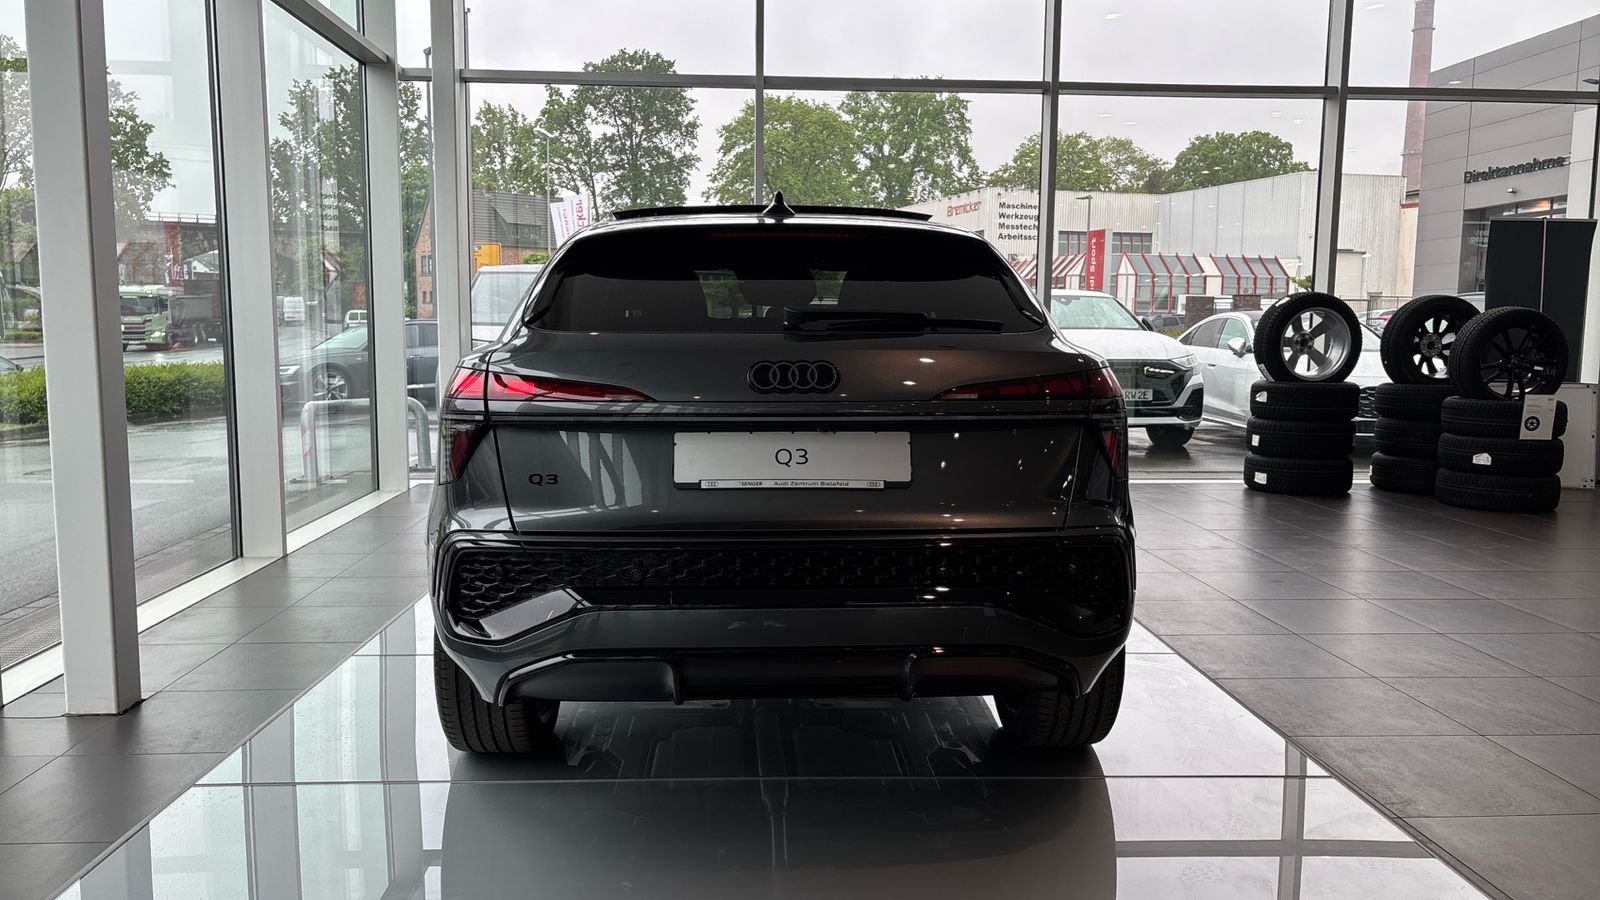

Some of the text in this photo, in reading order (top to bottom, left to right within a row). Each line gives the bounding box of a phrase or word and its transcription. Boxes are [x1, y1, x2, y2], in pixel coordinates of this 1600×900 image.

[1464, 156, 1567, 184] Direktannahme
[946, 200, 982, 217] Bremicker
[998, 202, 1038, 210] Maschine
[998, 212, 1039, 222] Werkzeug
[998, 222, 1039, 231] Messtech
[998, 233, 1038, 241] Arbeitssc
[1089, 236, 1097, 273] Sport
[774, 448, 809, 468] Q3
[528, 473, 558, 487] Q3
